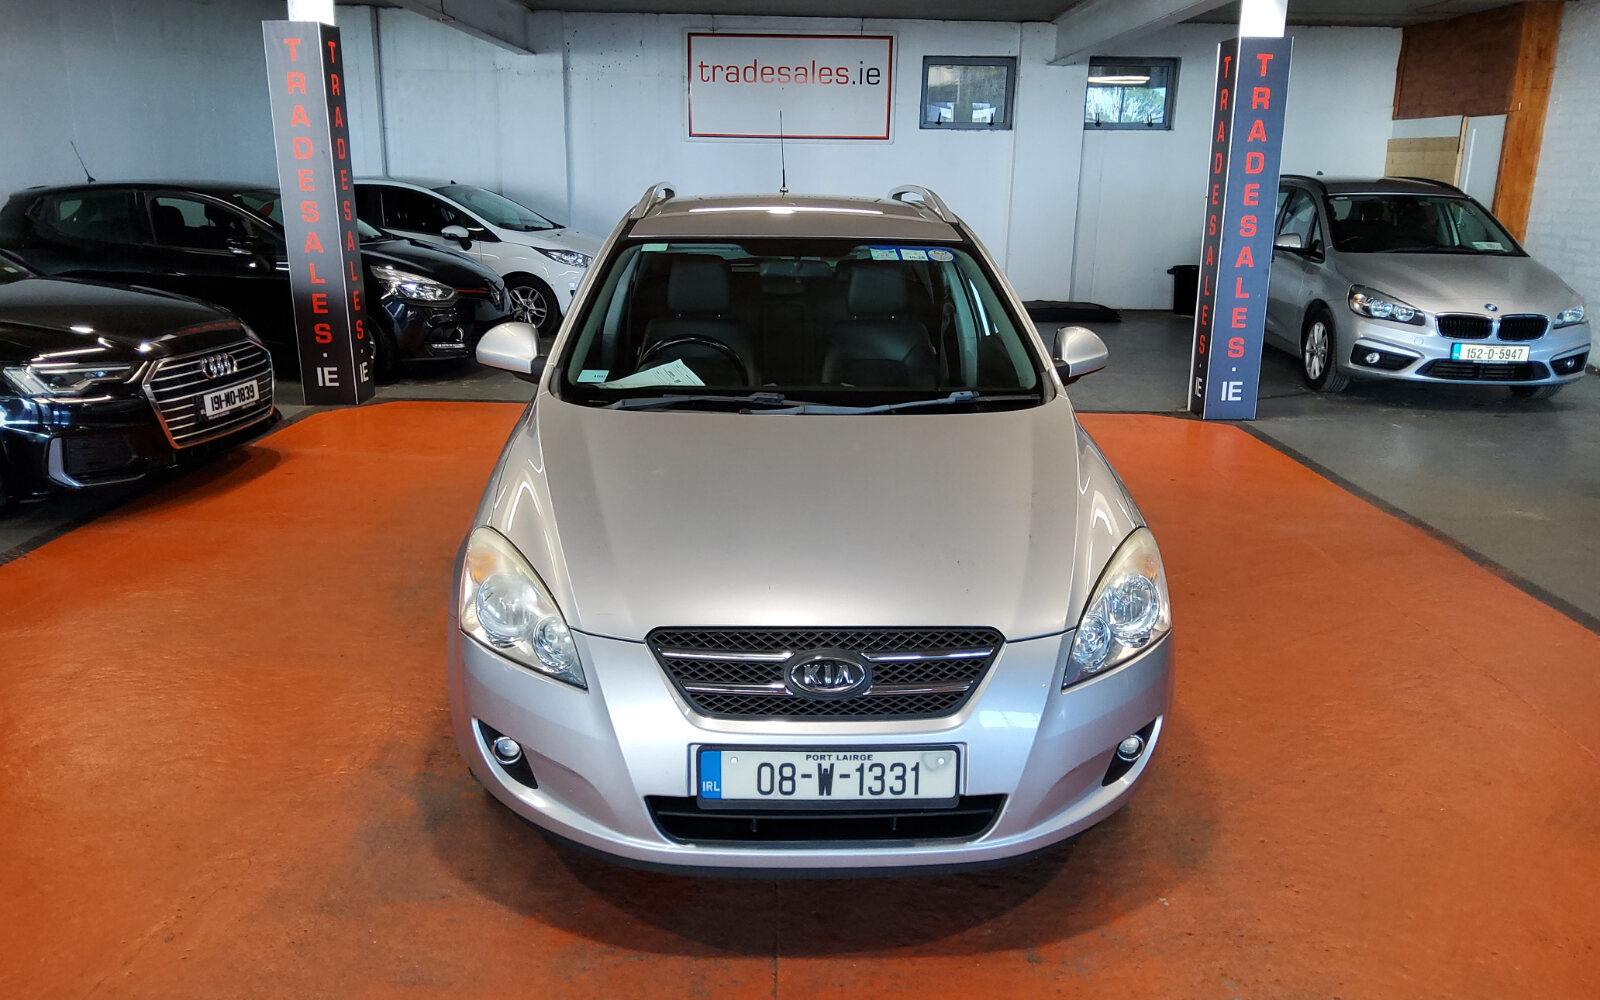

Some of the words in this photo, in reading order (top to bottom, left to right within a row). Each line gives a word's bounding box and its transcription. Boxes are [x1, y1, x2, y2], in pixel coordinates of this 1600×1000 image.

[698, 58, 881, 85] tradesales.ie
[1466, 348, 1523, 360] 152-D-5947
[210, 384, 255, 412] 191-MO-1839
[803, 664, 854, 685] KIA
[702, 780, 721, 792] IRL
[756, 762, 920, 796] 08-W-1331
